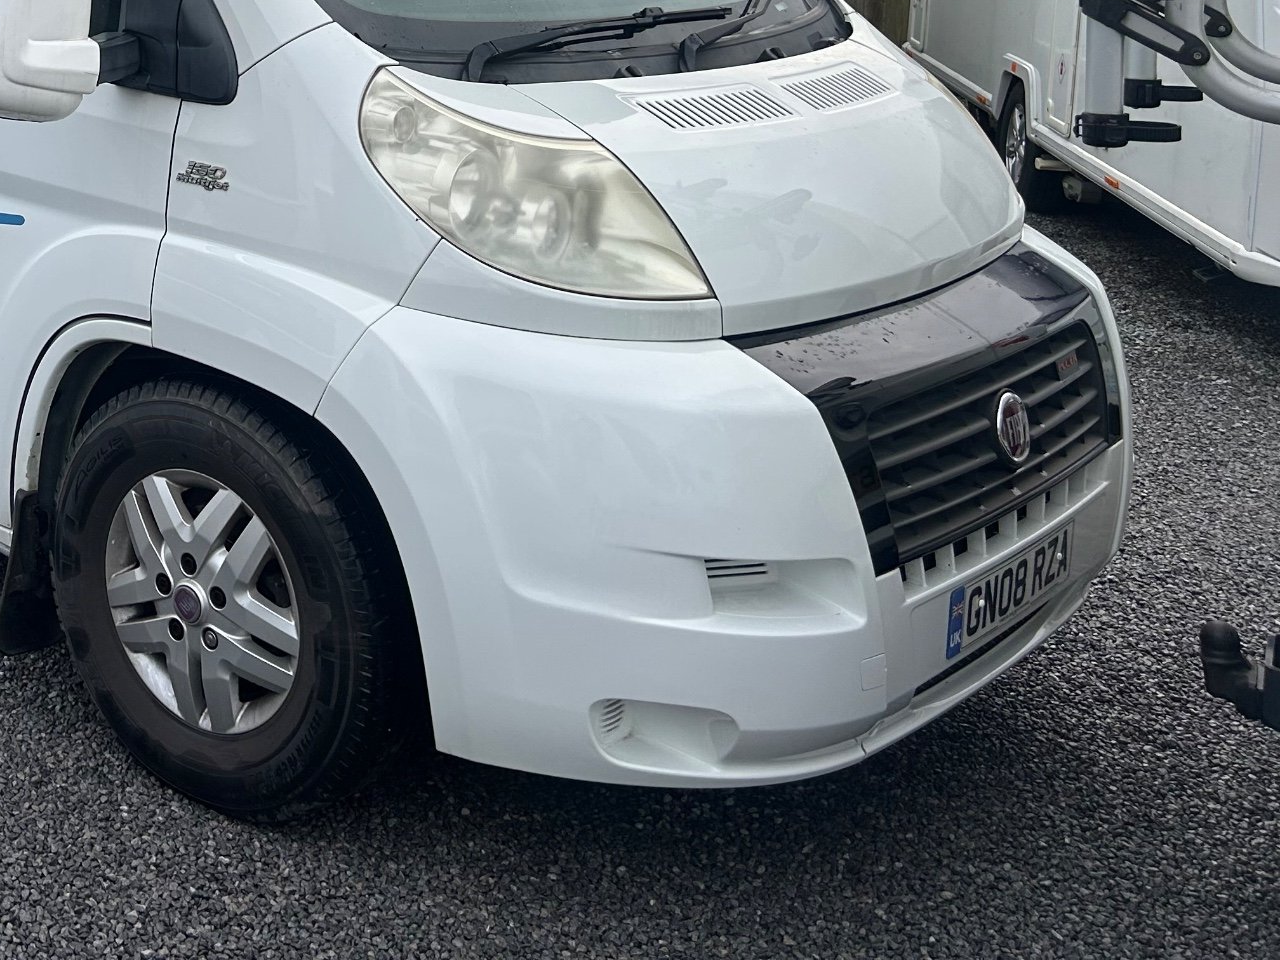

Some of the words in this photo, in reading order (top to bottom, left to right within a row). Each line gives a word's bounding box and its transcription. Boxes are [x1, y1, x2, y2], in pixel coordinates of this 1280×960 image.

[185, 160, 227, 181] 150
[966, 557, 1028, 637] GN08
[1030, 528, 1068, 597] RZA
[949, 628, 962, 648] UK
